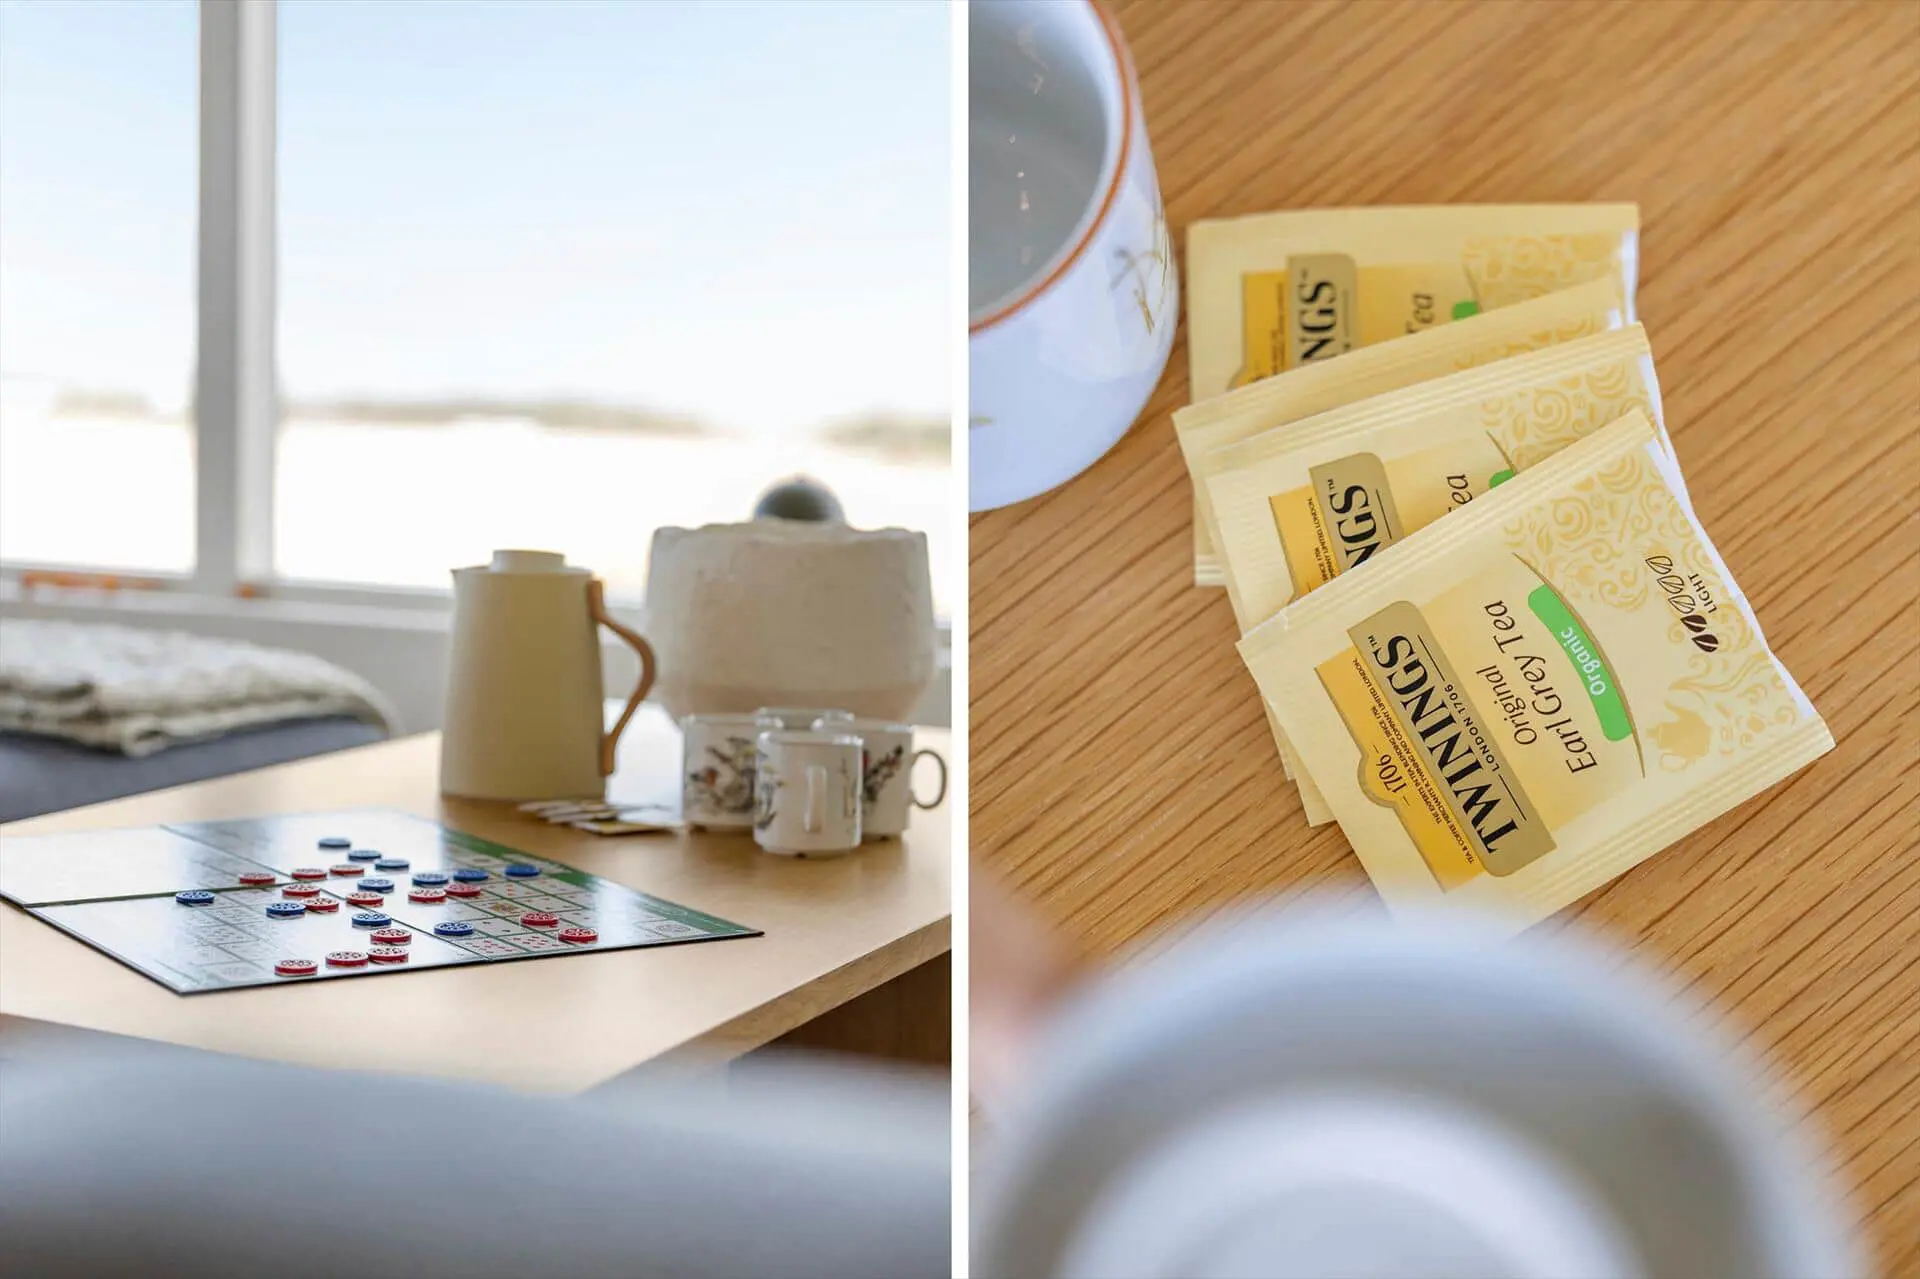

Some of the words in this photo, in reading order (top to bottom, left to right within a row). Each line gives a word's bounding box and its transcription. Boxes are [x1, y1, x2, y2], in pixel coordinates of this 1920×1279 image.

[1446, 474, 1473, 513] ea
[1687, 573, 1718, 614] LIGHT
[1484, 600, 1524, 654] Tea
[1513, 655, 1562, 716] Grey
[1560, 626, 1607, 696] Organic
[1444, 684, 1466, 715] 1706
[1475, 665, 1538, 745] Original
[1463, 716, 1500, 772] LONDON
[1544, 718, 1598, 774] Earl
[1375, 754, 1407, 793] 1706
